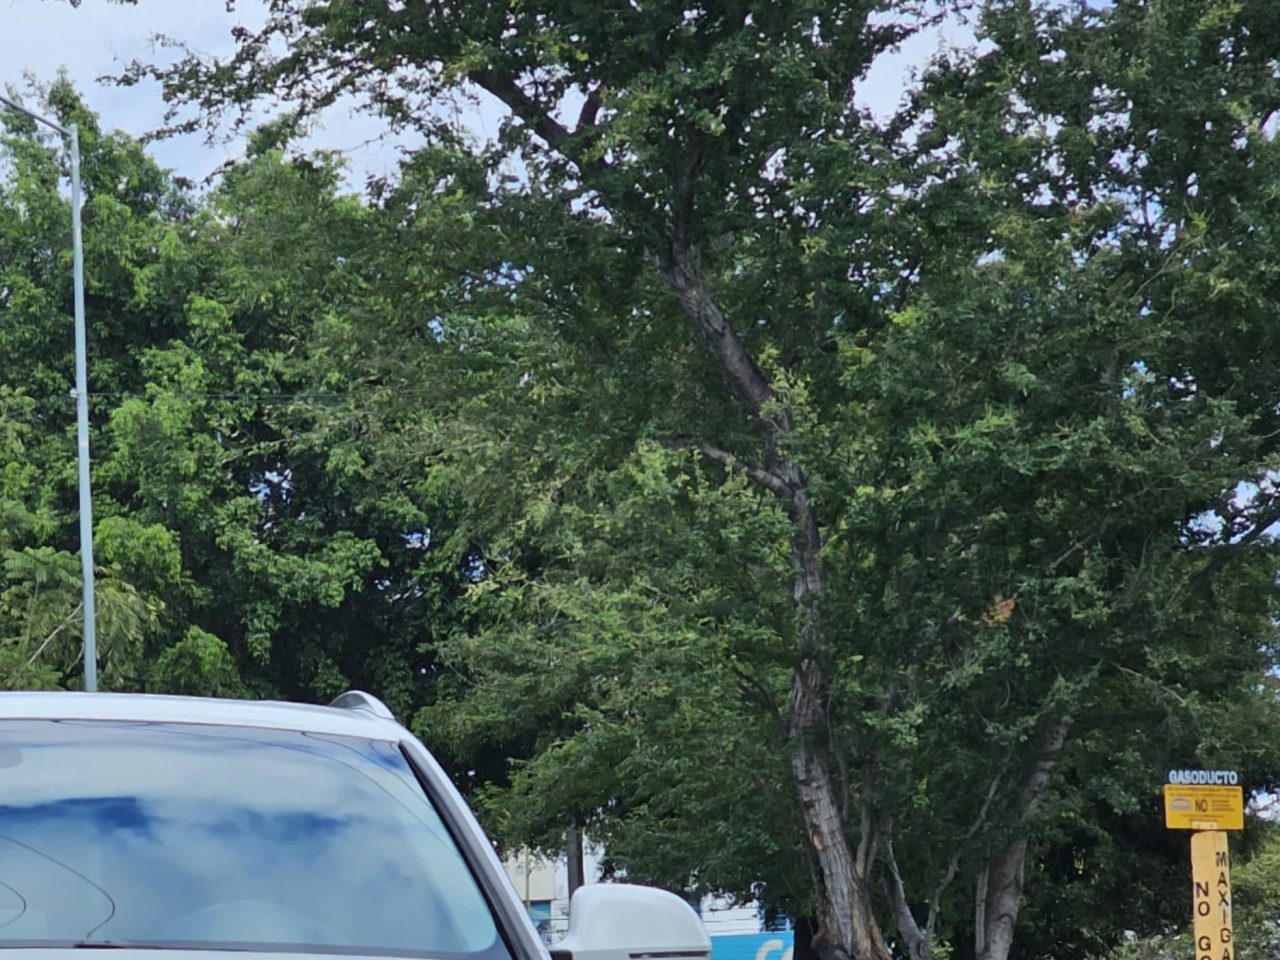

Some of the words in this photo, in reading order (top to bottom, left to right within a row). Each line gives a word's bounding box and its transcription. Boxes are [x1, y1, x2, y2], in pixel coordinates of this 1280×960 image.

[1169, 770, 1238, 785] GASODUCTO
[1195, 799, 1208, 813] NO
[1195, 881, 1210, 917] NO
